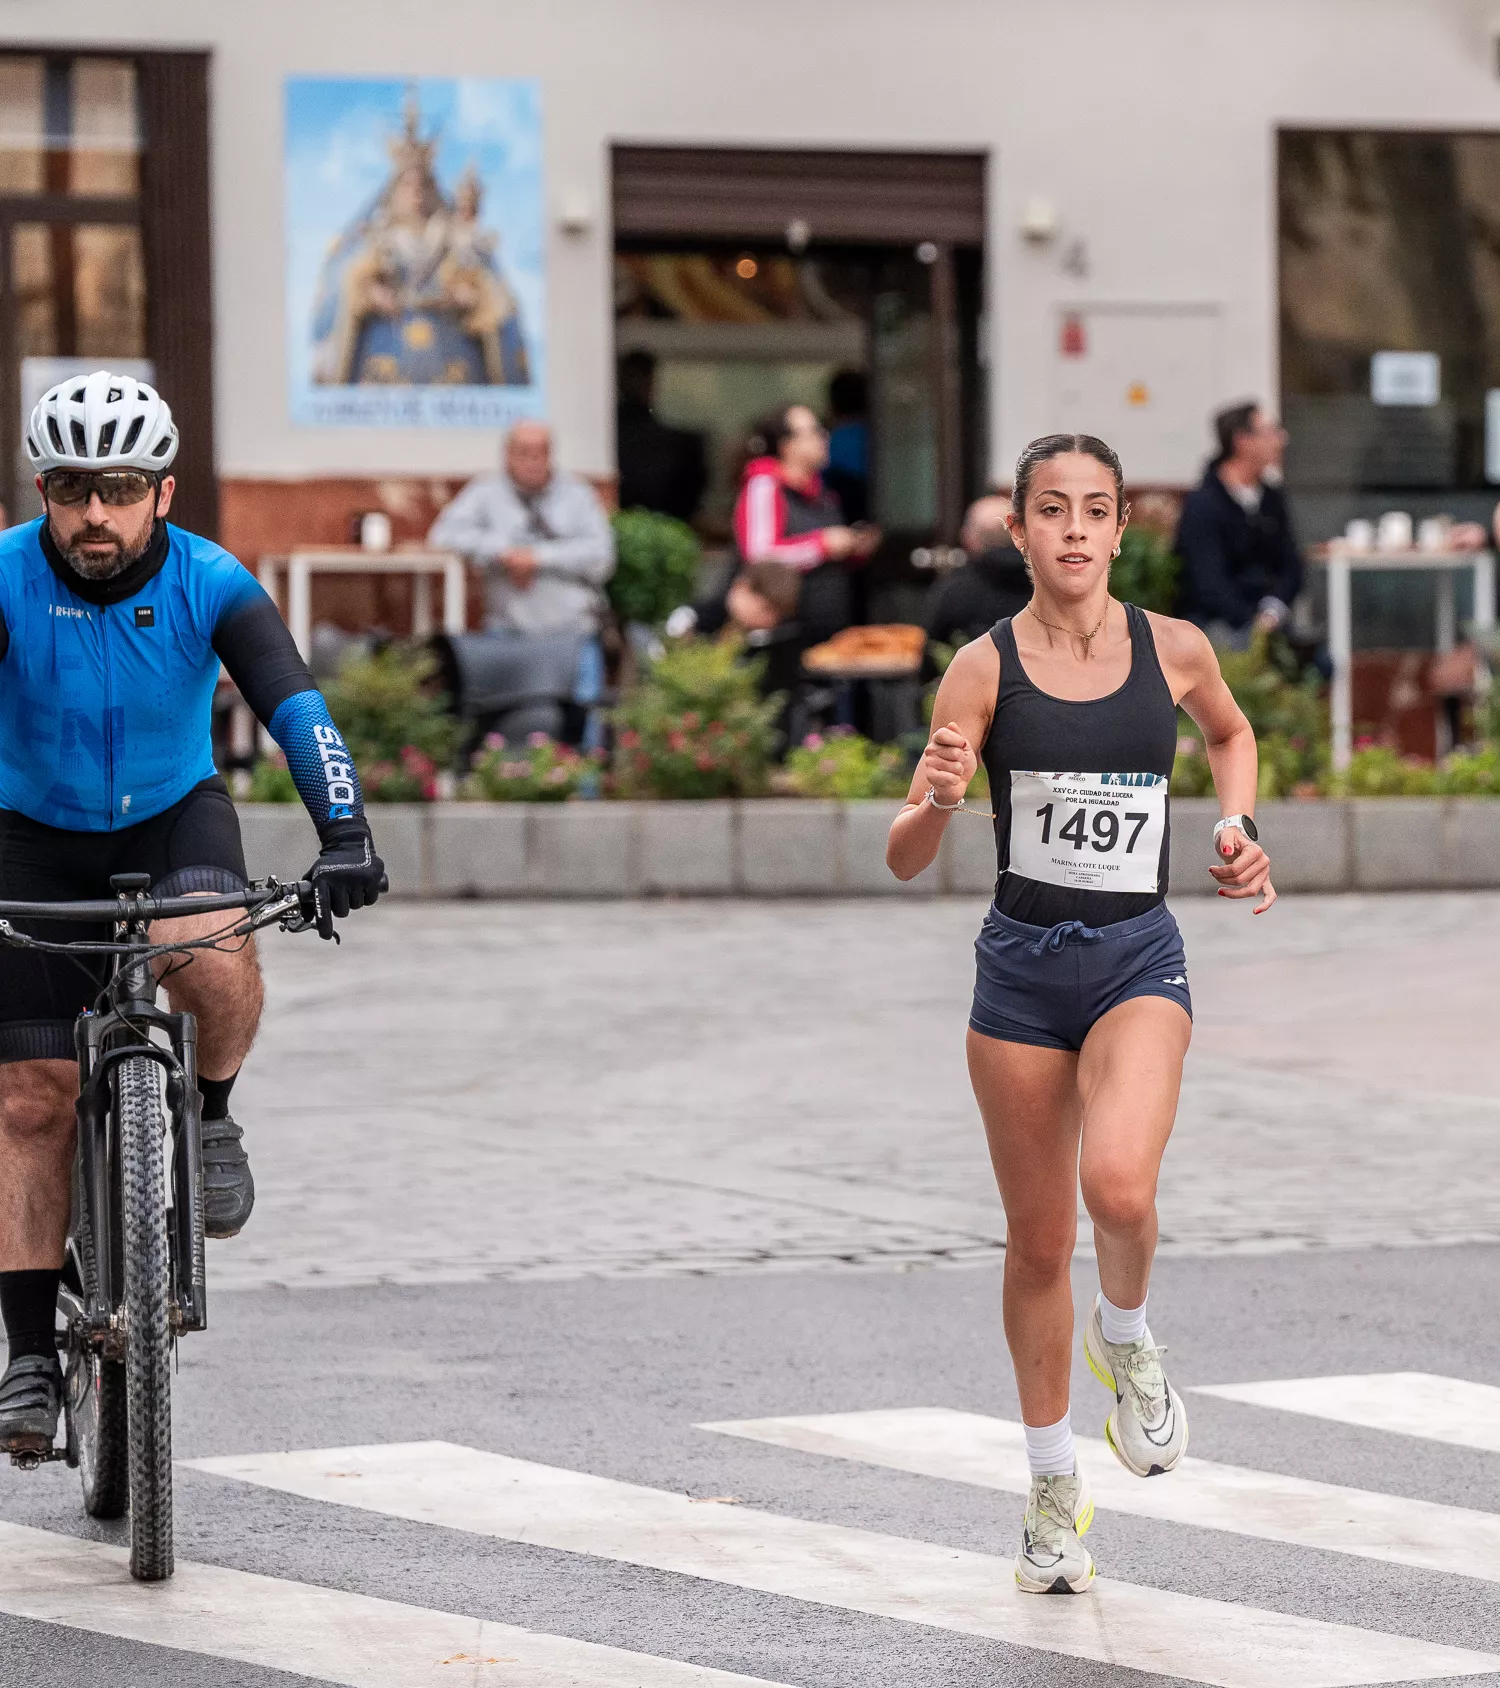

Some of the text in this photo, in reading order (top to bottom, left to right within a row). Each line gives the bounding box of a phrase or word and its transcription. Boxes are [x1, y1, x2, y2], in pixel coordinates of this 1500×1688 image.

[1088, 798, 1120, 806] IGUALDAD
[1036, 802, 1149, 854] 1497
[1051, 857, 1077, 867] MARINA
